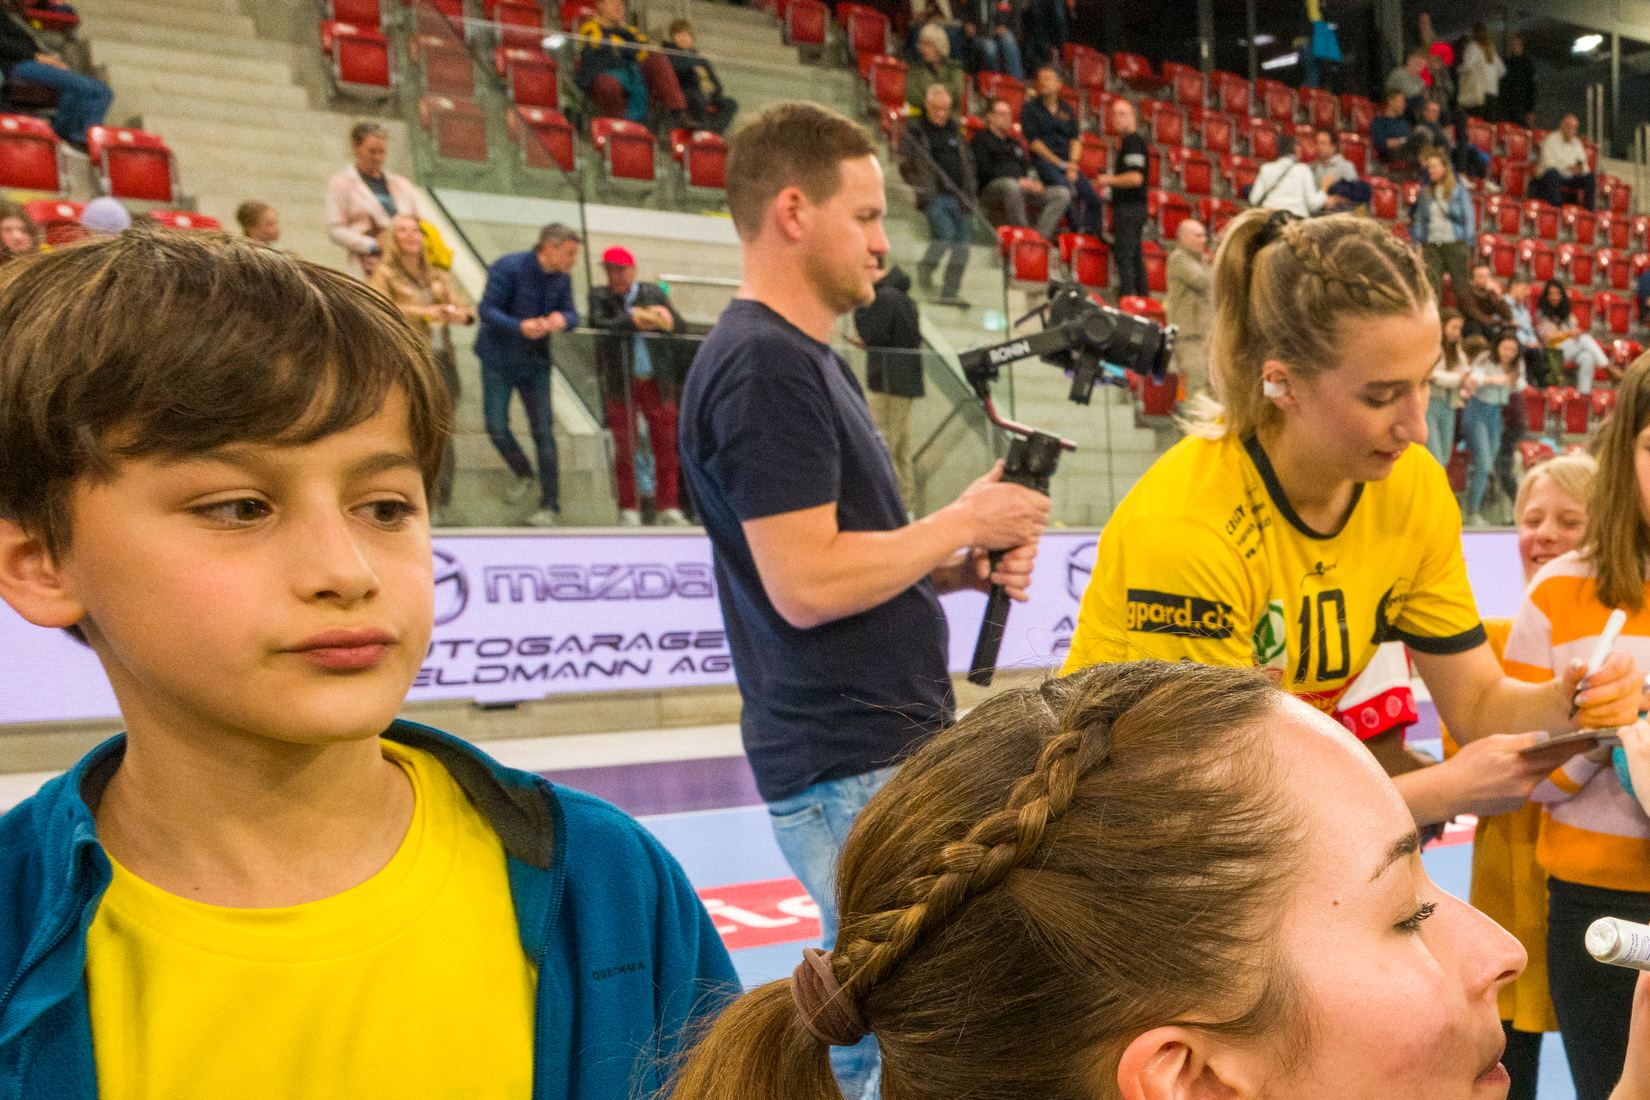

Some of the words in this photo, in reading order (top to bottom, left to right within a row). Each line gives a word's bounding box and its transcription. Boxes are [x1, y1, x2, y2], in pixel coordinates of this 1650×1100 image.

[1294, 589, 1350, 684] 10
[412, 659, 652, 687] ELDMANN
[669, 655, 733, 674] AG
